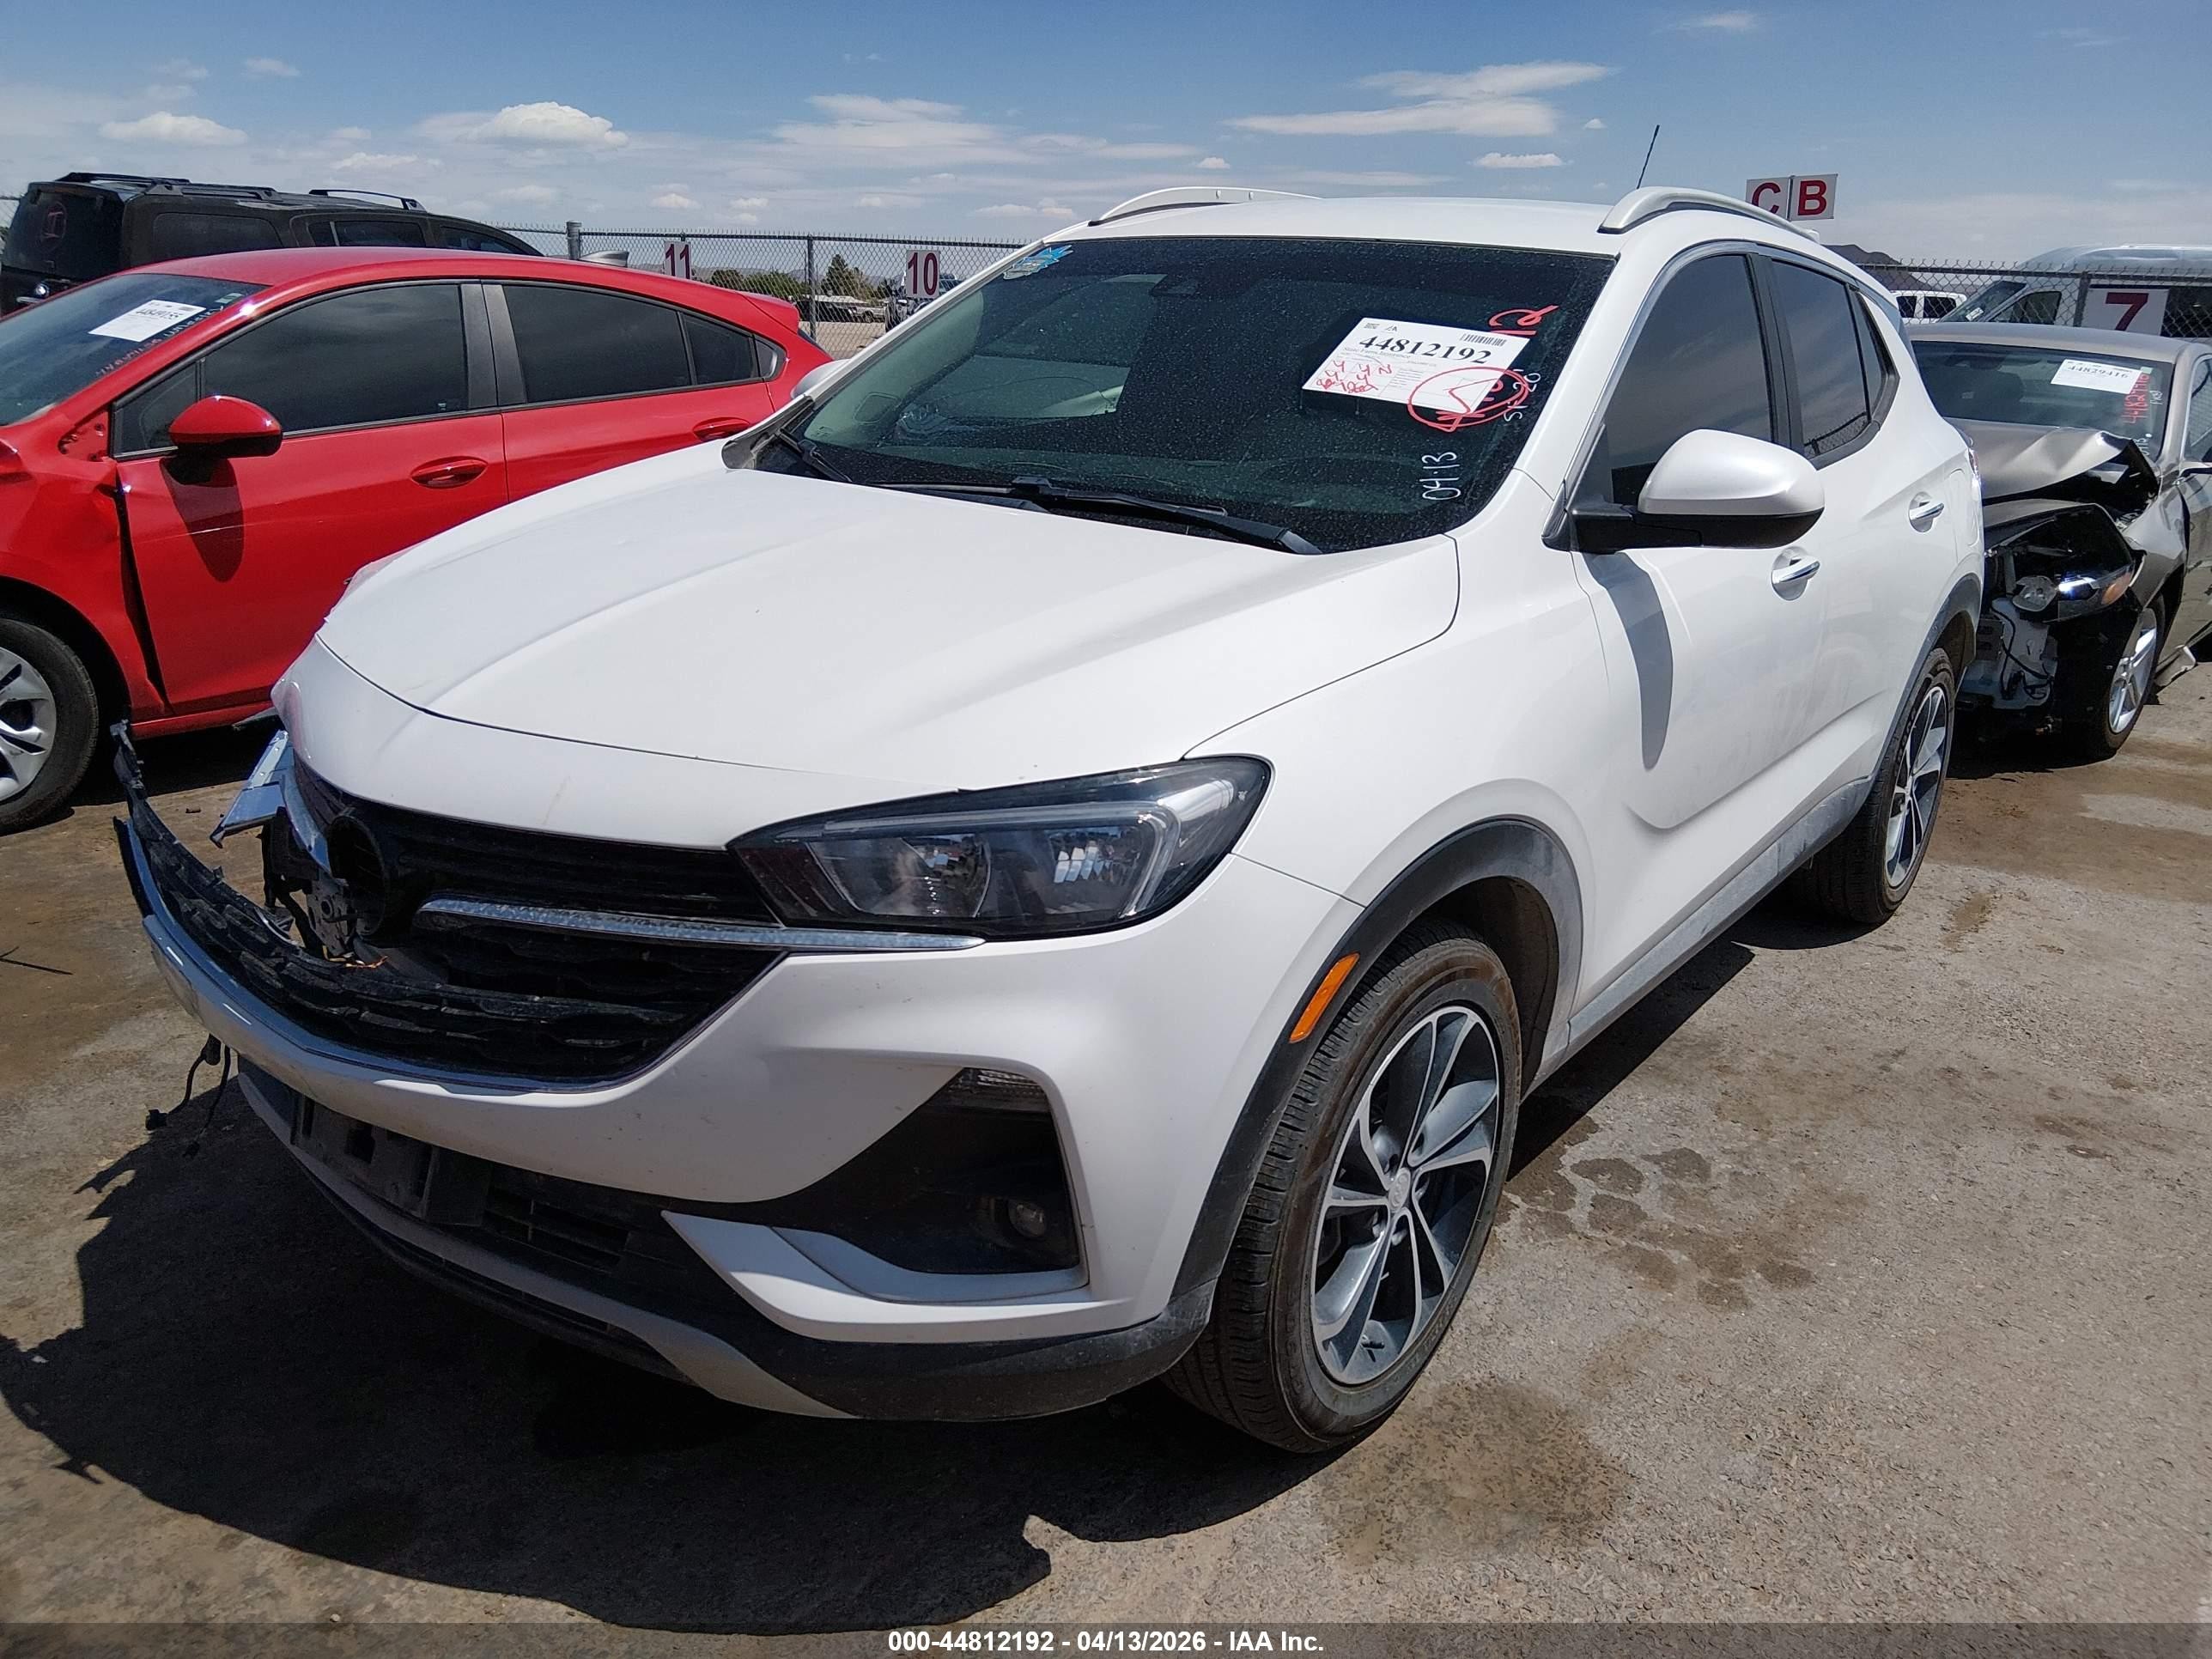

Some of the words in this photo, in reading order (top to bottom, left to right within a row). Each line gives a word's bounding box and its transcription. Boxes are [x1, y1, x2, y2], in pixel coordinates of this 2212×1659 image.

[1752, 182, 1781, 214] C
[1797, 179, 1827, 216] B
[665, 243, 691, 280] 11
[907, 252, 938, 295] 10
[2105, 292, 2149, 331] 7
[1359, 336, 1492, 364] 44812192
